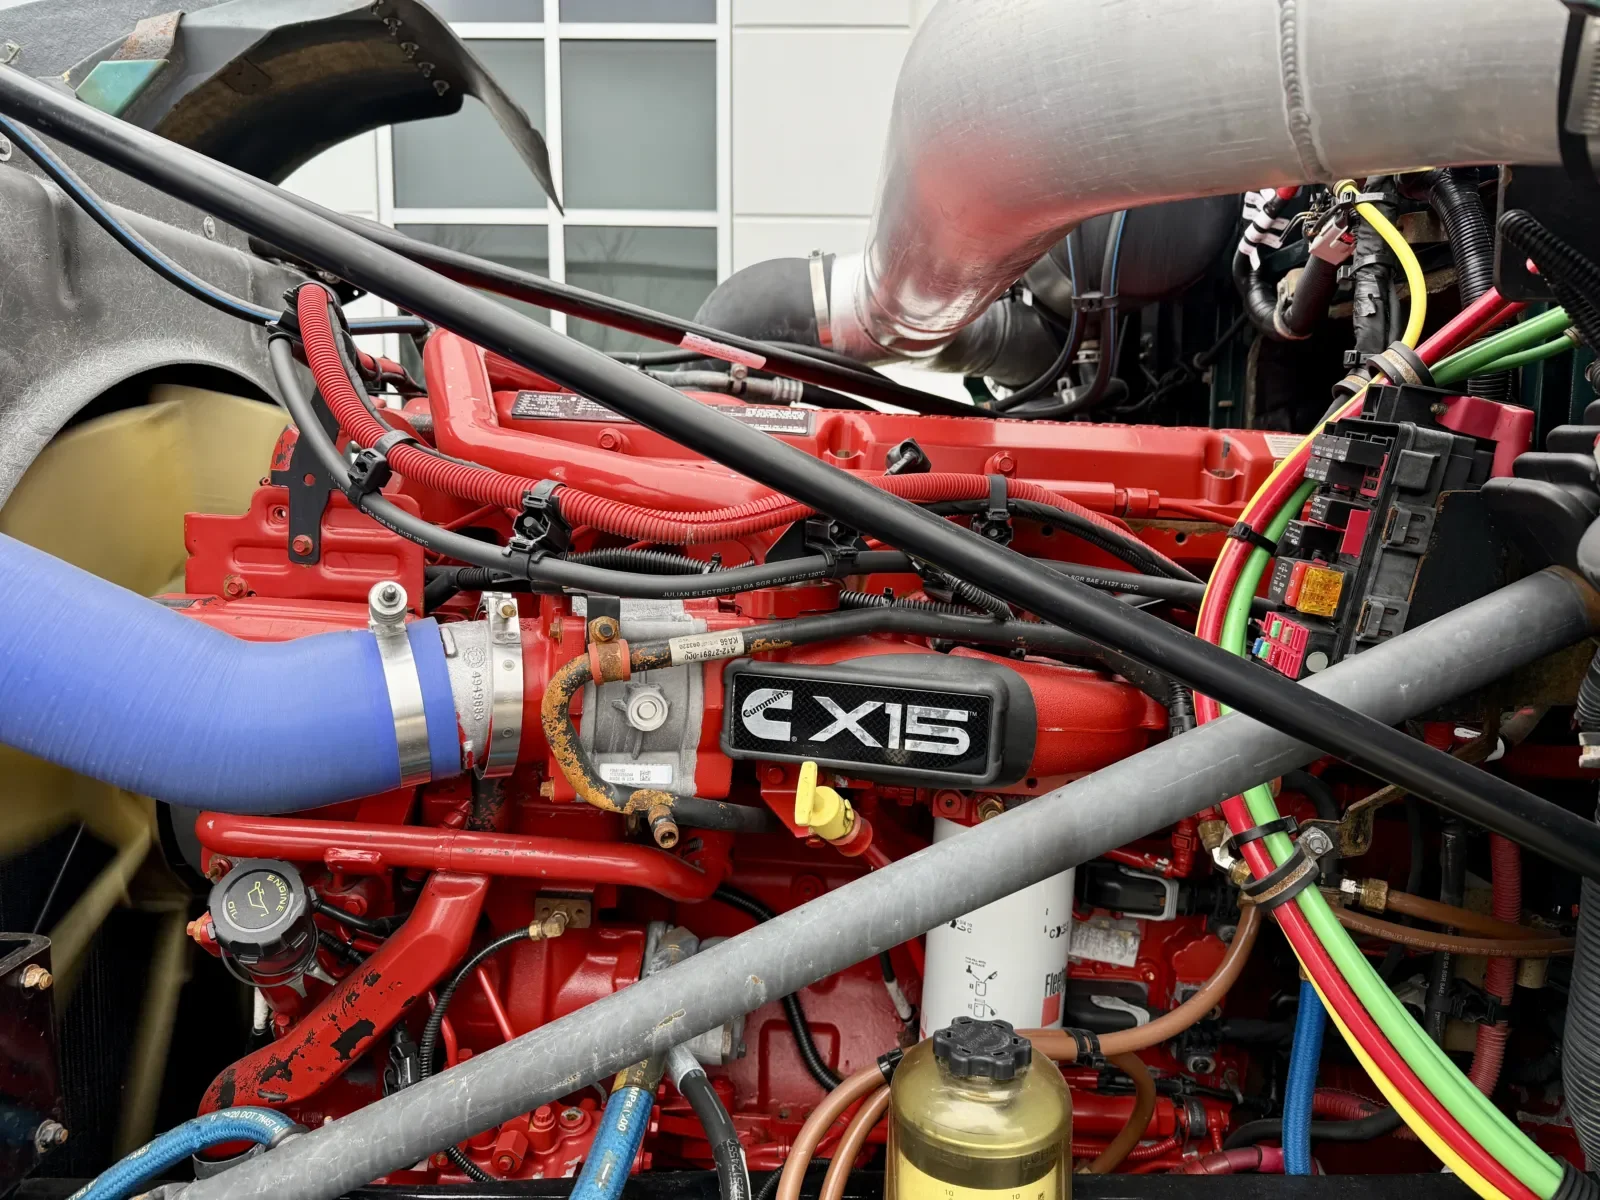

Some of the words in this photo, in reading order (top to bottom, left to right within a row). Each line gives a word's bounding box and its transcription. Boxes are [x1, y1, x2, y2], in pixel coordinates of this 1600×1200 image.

[692, 587, 730, 597] ELECTRIC
[756, 579, 771, 588] SGR
[788, 573, 806, 582] J1127
[1086, 577, 1099, 585] SAE
[1100, 579, 1119, 588] J1127
[742, 690, 789, 718] Cummins
[808, 695, 971, 756] X15
[267, 874, 288, 913] ENGINE
[227, 900, 239, 920] OIL
[240, 1110, 257, 1120] DOT
